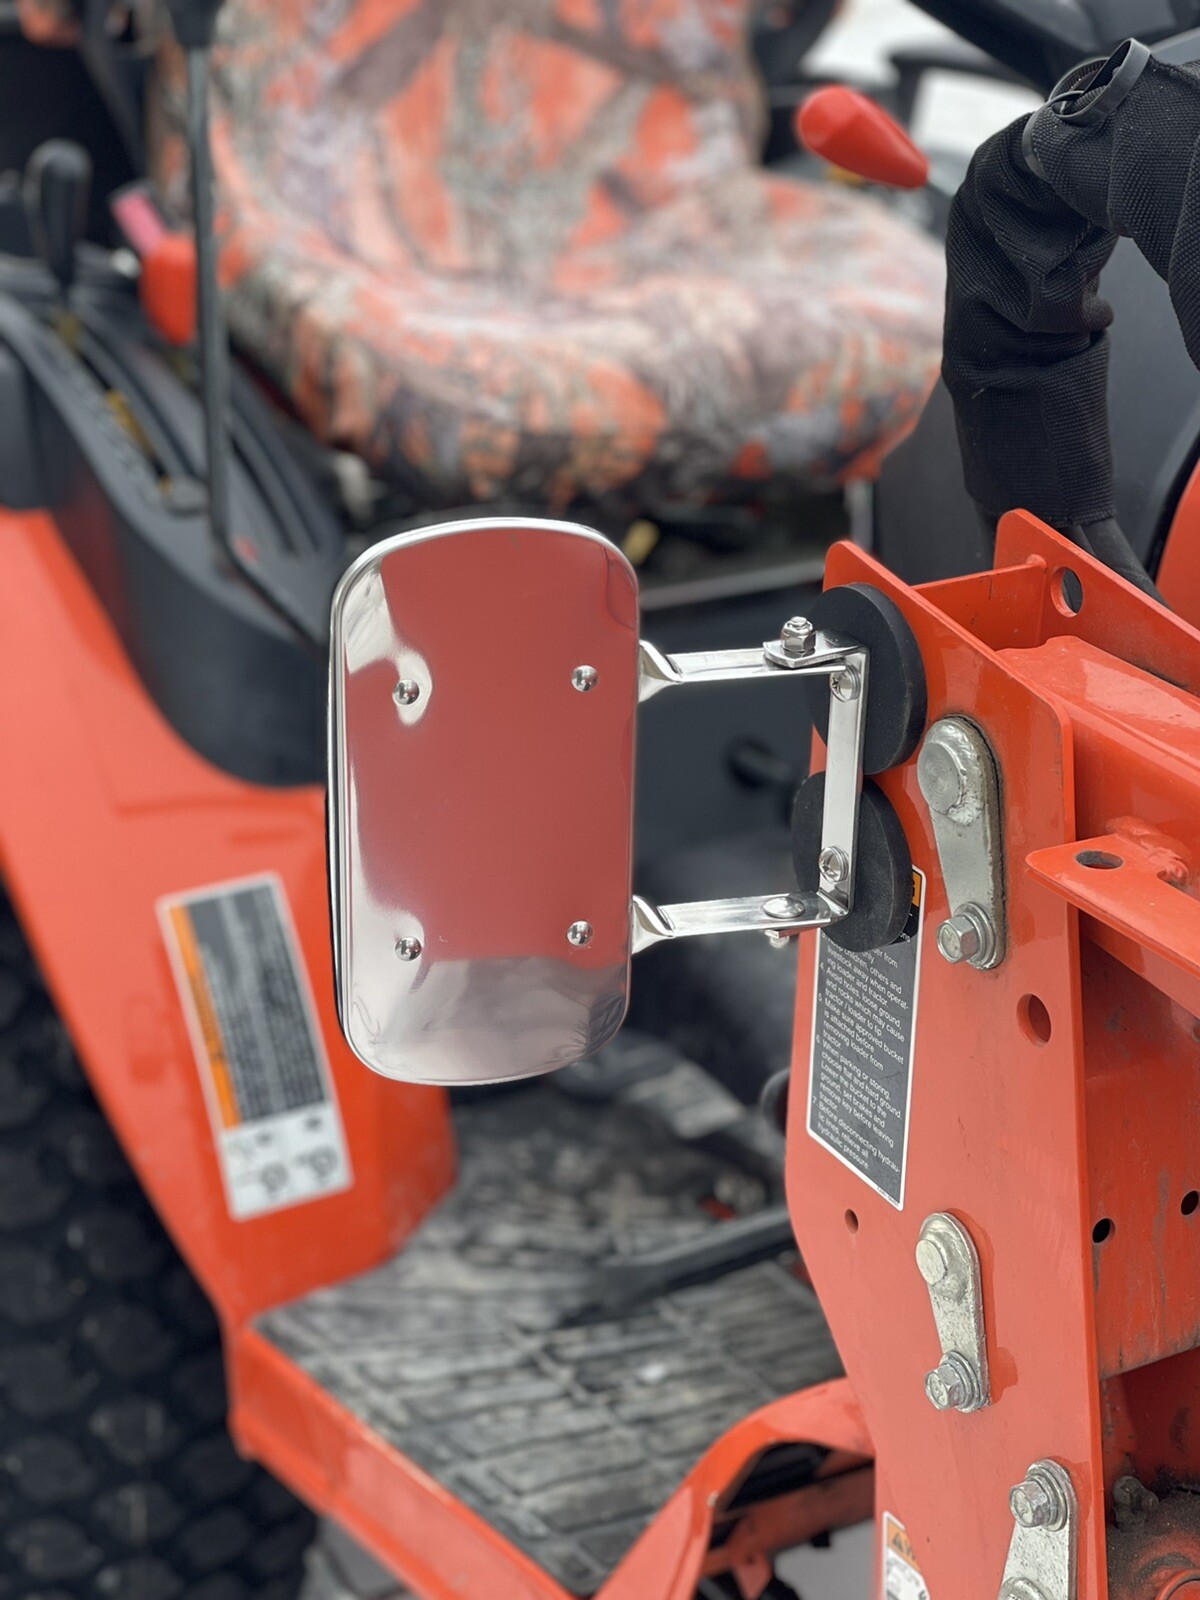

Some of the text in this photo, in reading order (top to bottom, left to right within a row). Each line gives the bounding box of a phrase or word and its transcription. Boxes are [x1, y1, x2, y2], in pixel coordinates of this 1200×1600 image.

[827, 944, 852, 970] livestock
[853, 965, 869, 983] away
[869, 978, 886, 994] when
[827, 958, 836, 970] ing
[837, 963, 855, 982] loader
[855, 978, 868, 992] and
[869, 966, 889, 985] others
[889, 981, 902, 995] and
[884, 952, 898, 969] from
[825, 987, 844, 1006] tractor
[848, 1005, 867, 1024] loader
[867, 1019, 874, 1030] to
[825, 978, 905, 1043] and rocks which may cause
[826, 967, 843, 984] Avoid
[862, 993, 878, 1011] loose
[823, 1020, 884, 1071] removing loader from
[824, 997, 841, 1016] Make
[841, 1012, 855, 1027] sure
[855, 1022, 883, 1048] approved
[883, 1043, 904, 1065] bucket
[830, 1014, 855, 1038] attached
[855, 1032, 875, 1053] before
[821, 1051, 842, 1072] choose
[843, 1066, 853, 1080] flat
[853, 1076, 865, 1090] and
[865, 1084, 879, 1101] hard
[822, 1039, 840, 1058] When
[839, 1055, 862, 1078] parking
[862, 1072, 869, 1081] or
[821, 1060, 887, 1118] Lower the bucket to the
[843, 1090, 852, 1102] set
[852, 1096, 873, 1118] brakes
[873, 1114, 886, 1128] and
[817, 1121, 843, 1148] hydraulic
[818, 1101, 838, 1122] Before
[837, 1118, 878, 1157] disconnecting
[820, 1082, 894, 1148] remove key before leaving
[841, 1132, 861, 1152] relieve
[861, 1148, 869, 1159] all
